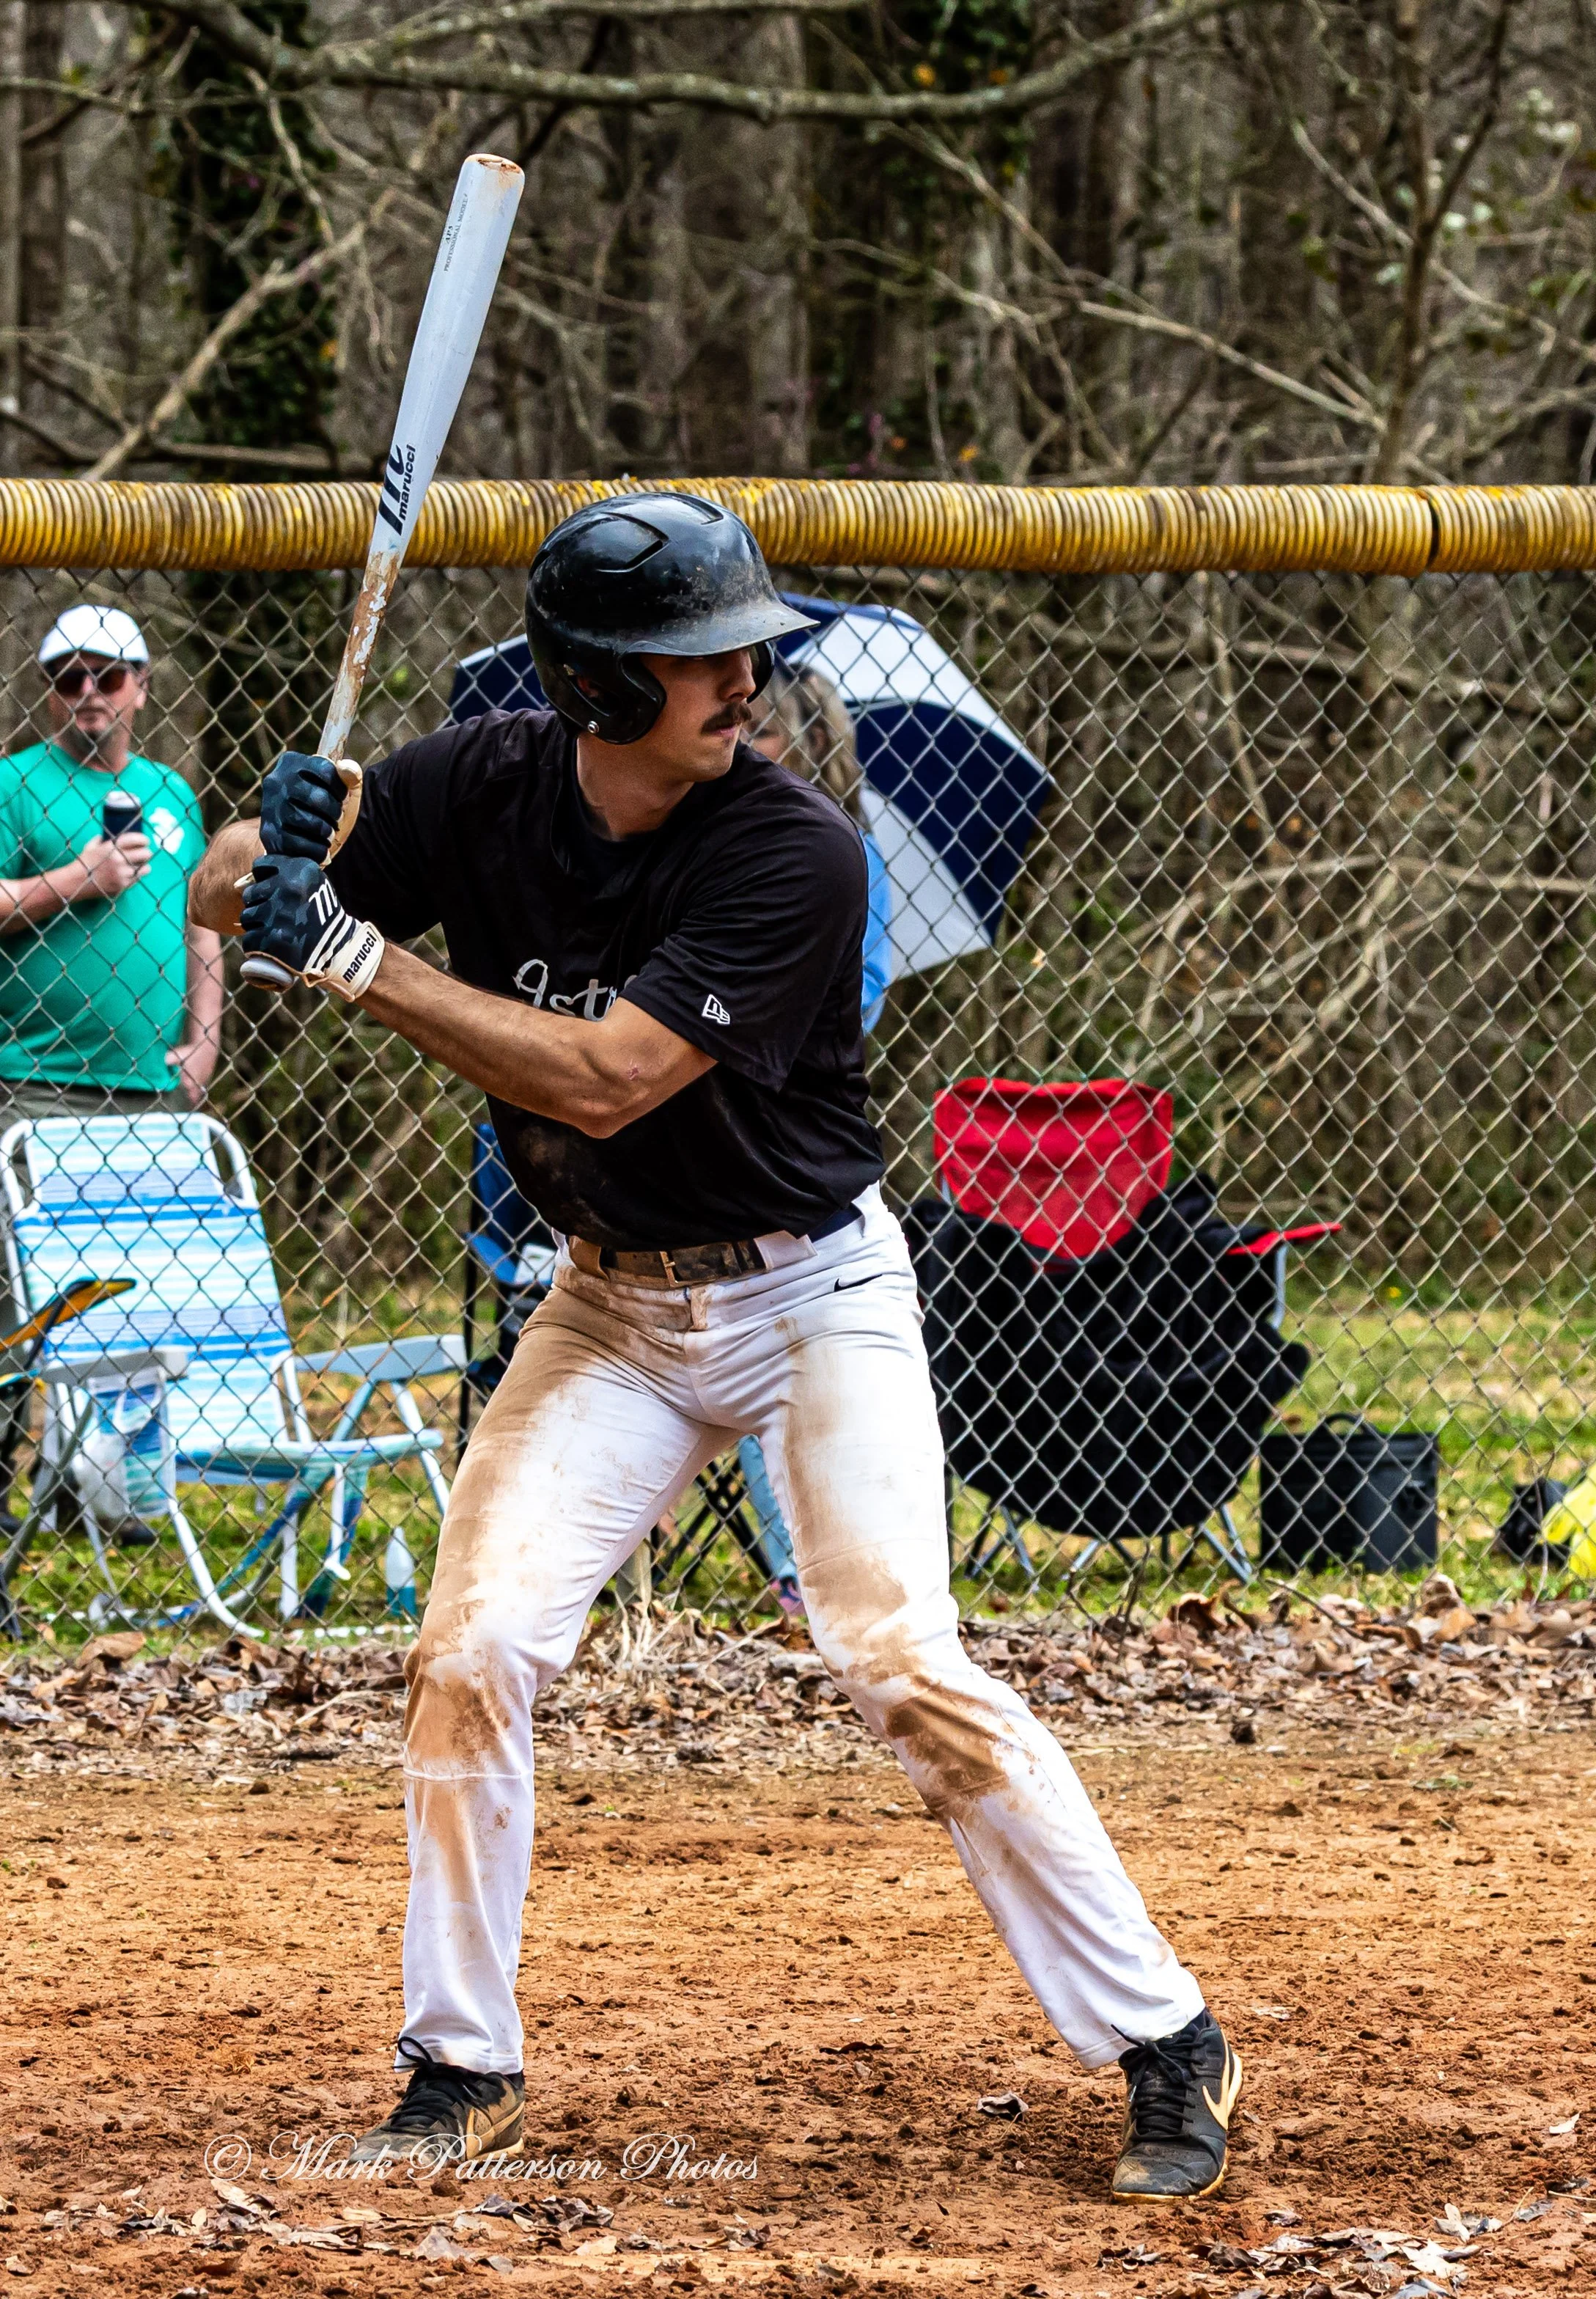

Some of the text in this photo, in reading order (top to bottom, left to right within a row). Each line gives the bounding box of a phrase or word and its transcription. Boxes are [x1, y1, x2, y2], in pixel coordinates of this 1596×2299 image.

[444, 224, 461, 271] PROFESSIONAL
[399, 444, 416, 521] marucci
[342, 931, 378, 983] marucci
